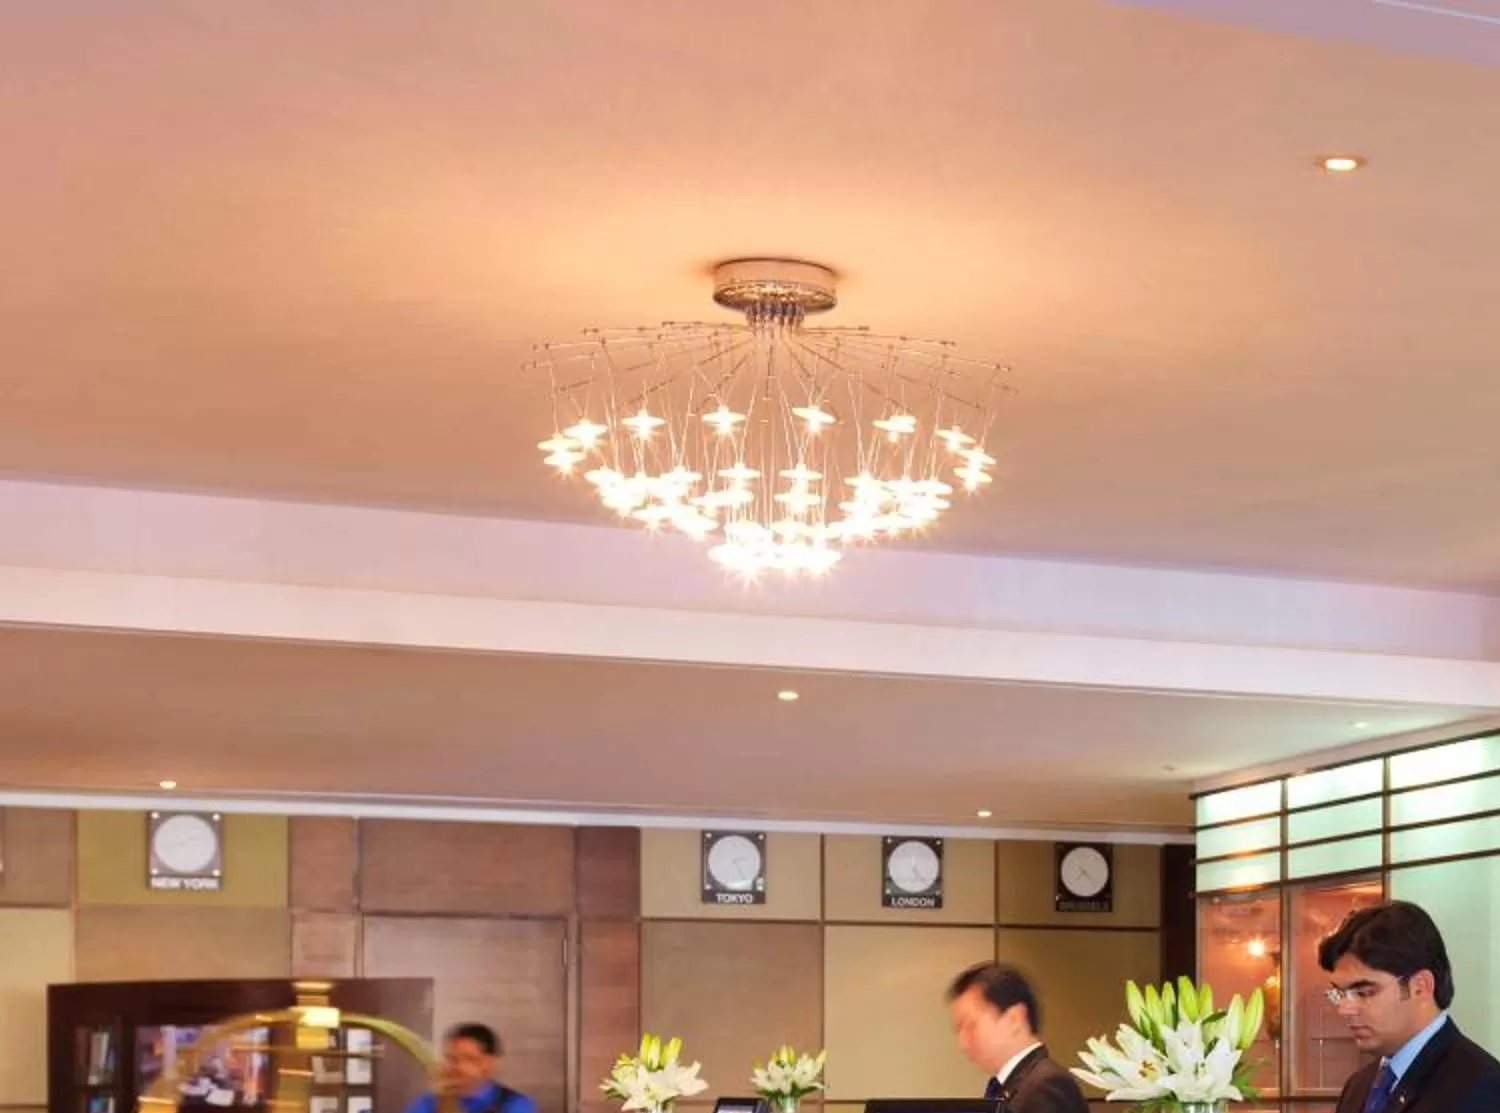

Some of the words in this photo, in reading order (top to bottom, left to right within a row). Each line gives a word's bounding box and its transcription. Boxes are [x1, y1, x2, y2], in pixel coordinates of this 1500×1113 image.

[151, 877, 181, 889] NEW
[183, 877, 219, 891] YORK
[715, 893, 753, 905] TOKYO
[891, 896, 935, 908] LONDON
